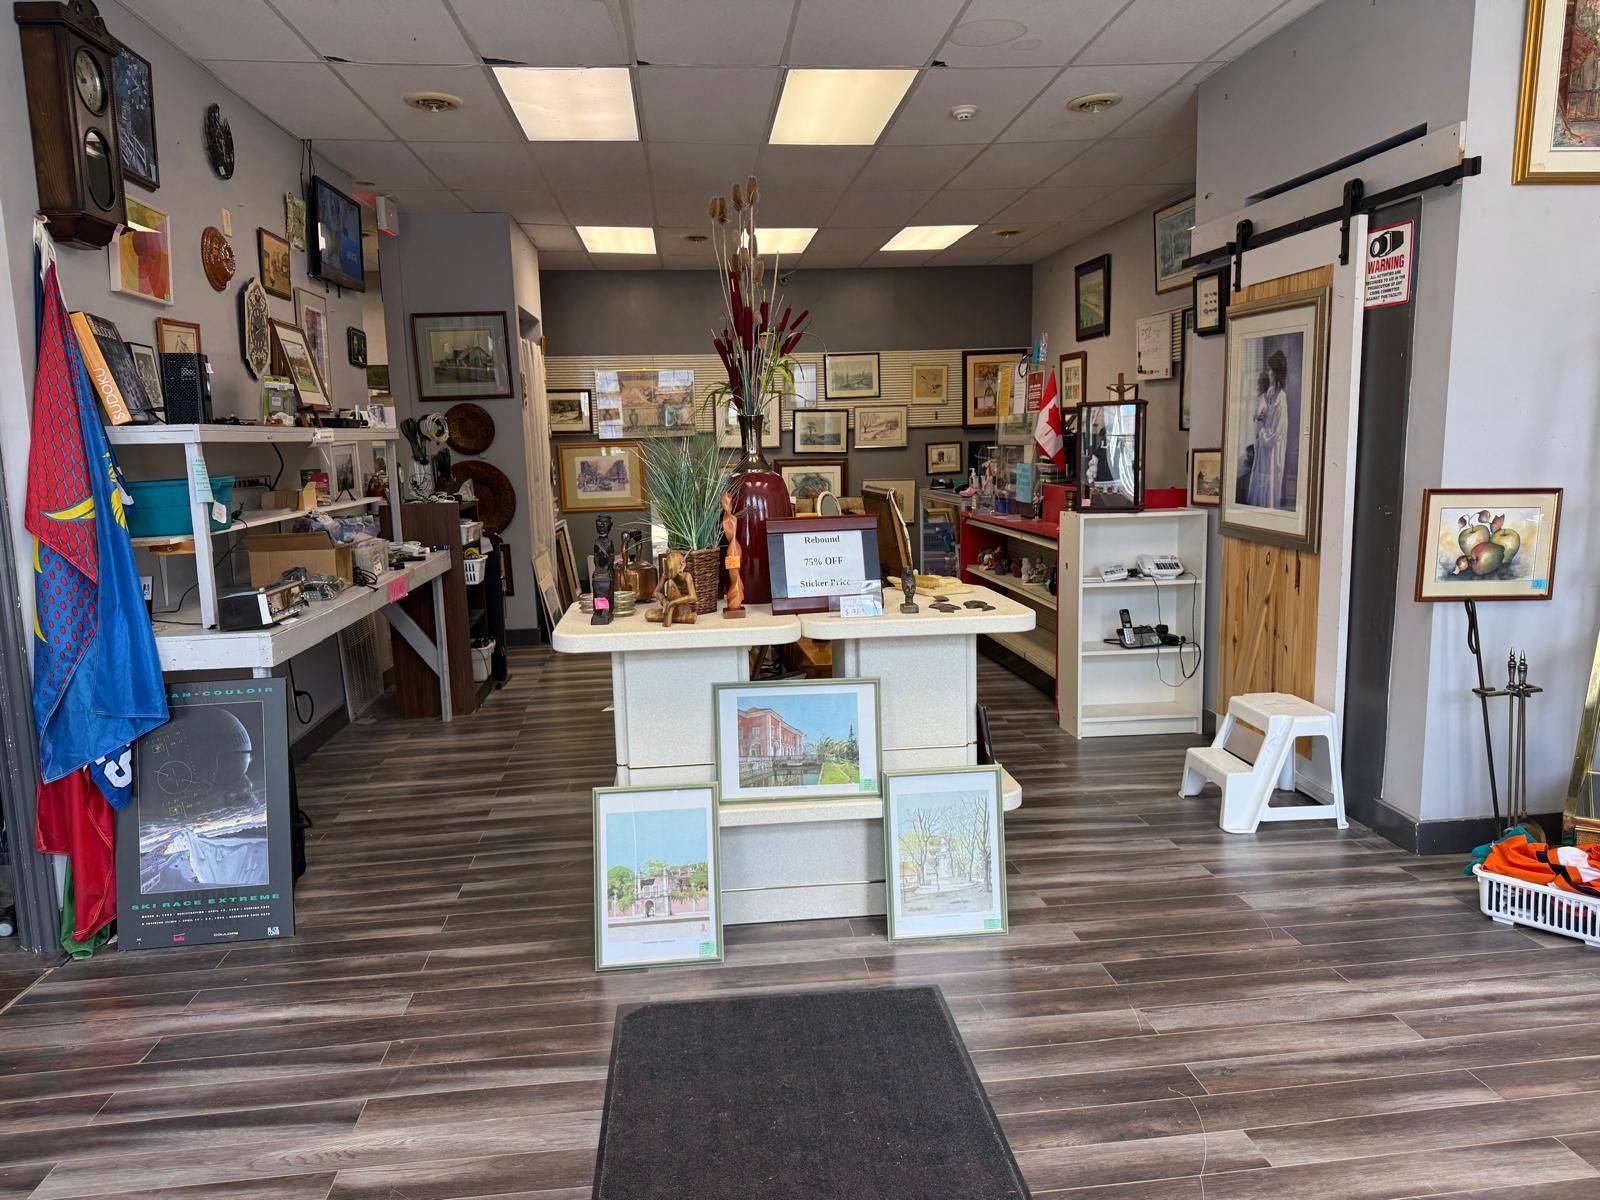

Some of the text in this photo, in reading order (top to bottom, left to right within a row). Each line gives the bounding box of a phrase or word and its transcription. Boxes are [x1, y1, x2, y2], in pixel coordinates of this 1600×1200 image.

[1368, 254, 1405, 274] WARNING
[93, 367, 126, 420] SUDOKU
[804, 535, 840, 544] Rebound
[804, 556, 844, 567] 75% OFF
[800, 579, 829, 588] Sticker
[131, 893, 281, 911] SKI RACE EXTREME
